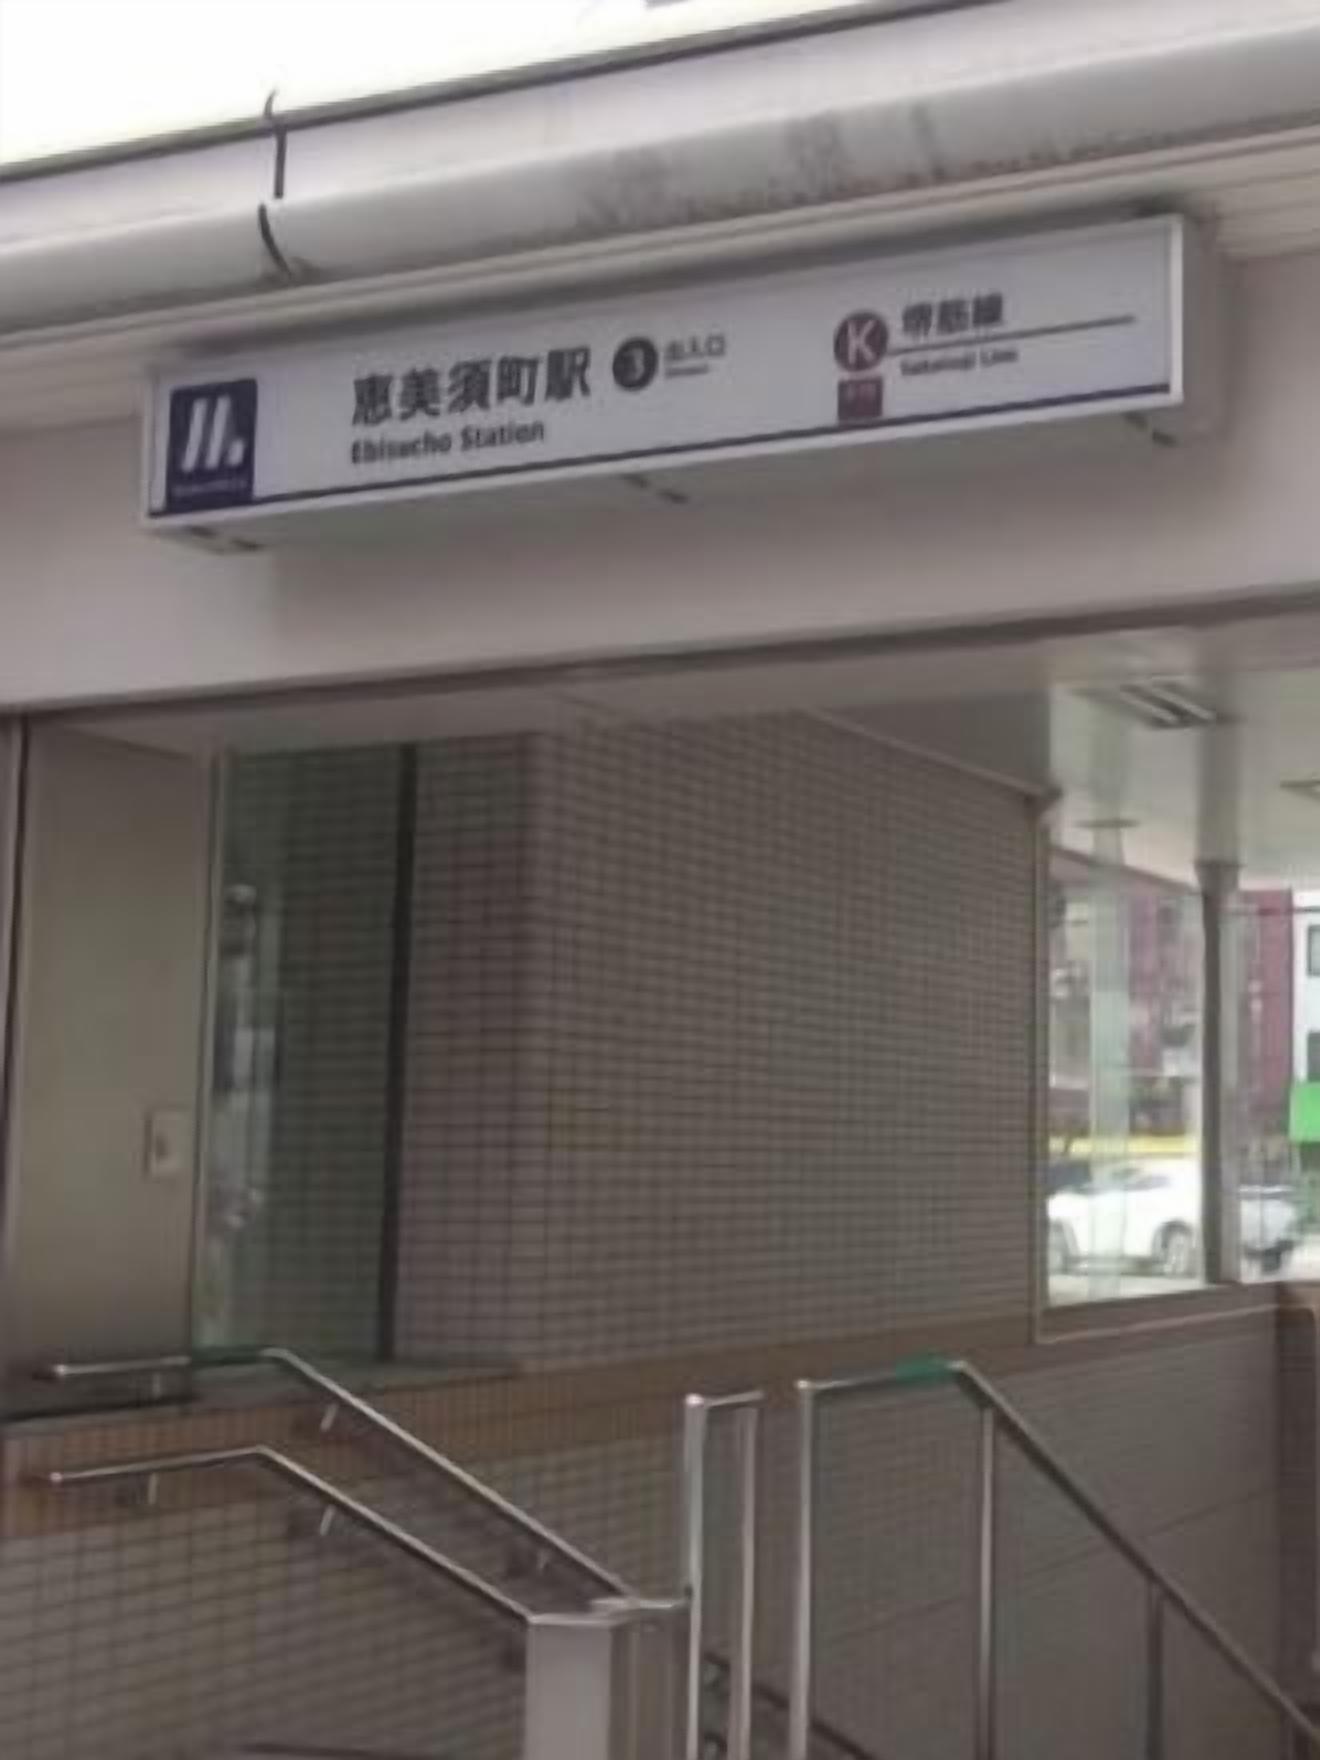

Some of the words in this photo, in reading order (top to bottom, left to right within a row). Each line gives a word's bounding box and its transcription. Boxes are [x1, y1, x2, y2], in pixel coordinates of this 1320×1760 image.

[352, 345, 591, 427] 恵美須町駅
[460, 420, 544, 452] Station
